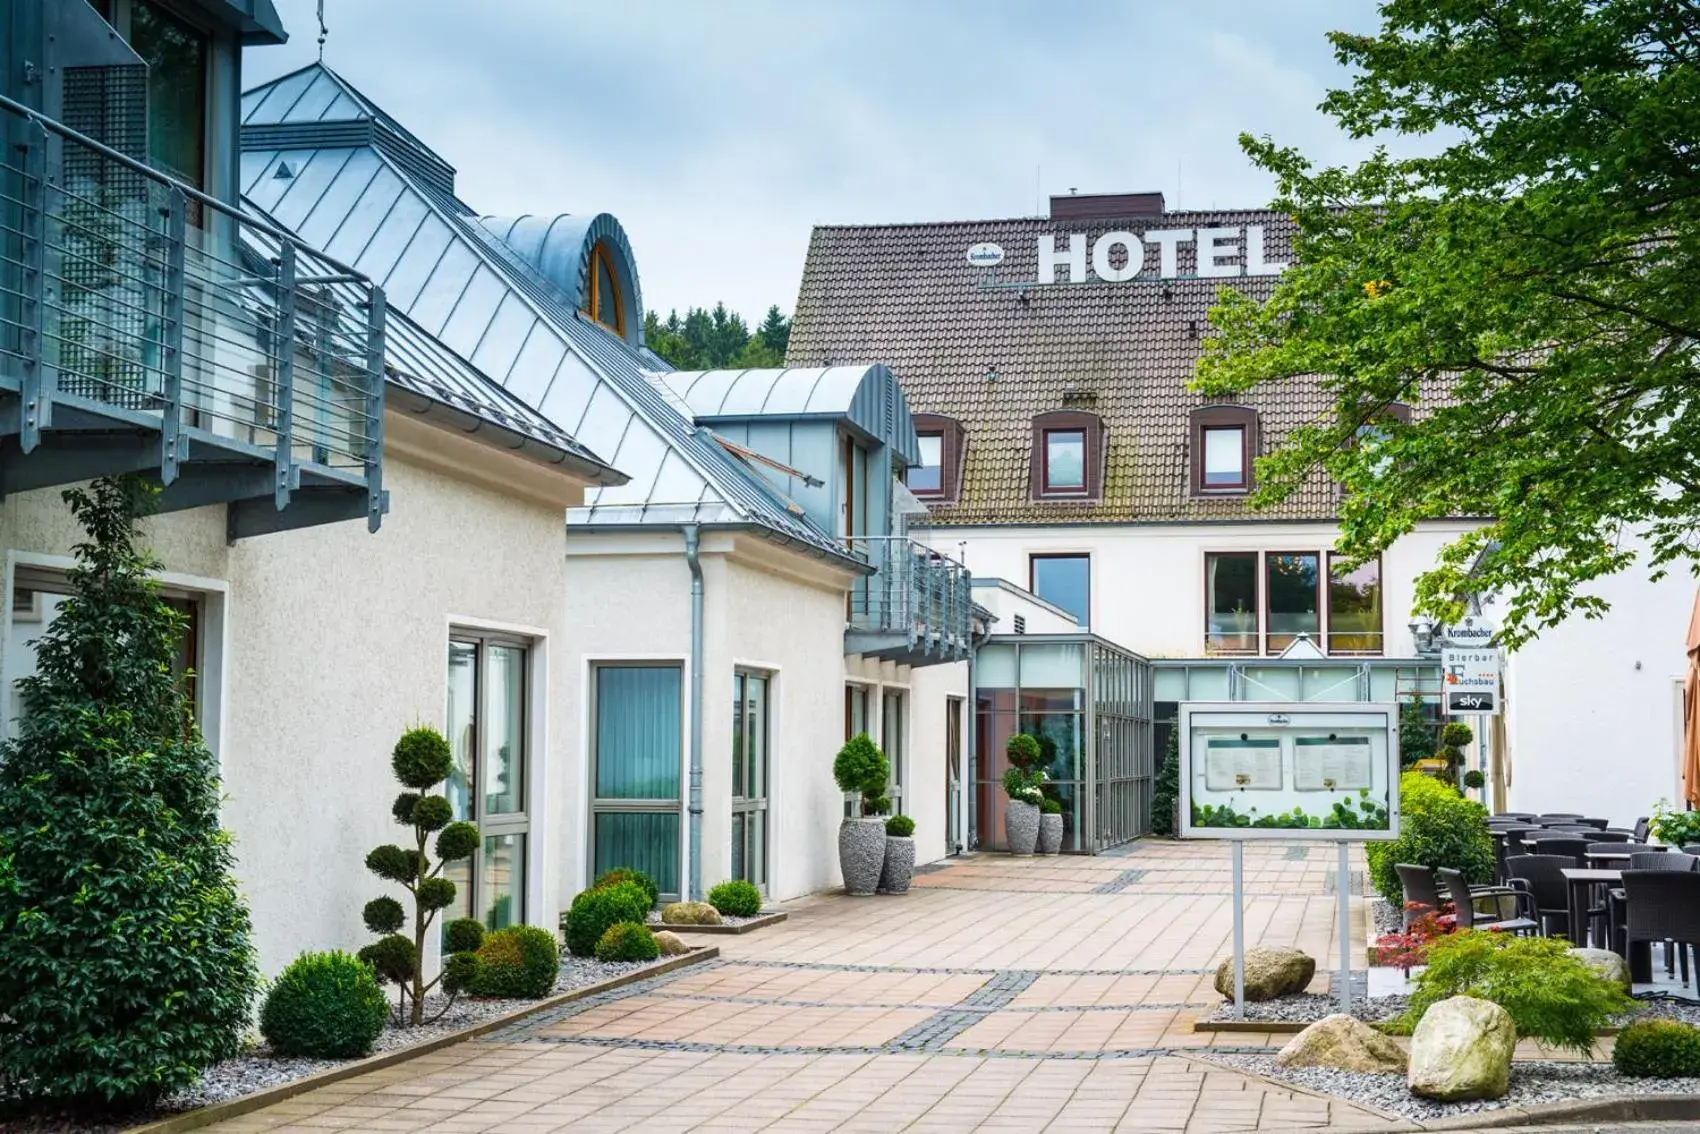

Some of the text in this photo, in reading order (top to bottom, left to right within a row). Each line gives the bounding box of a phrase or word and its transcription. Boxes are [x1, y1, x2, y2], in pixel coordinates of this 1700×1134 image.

[1037, 226, 1289, 285] HOTEL
[1447, 627, 1492, 638] Krombacher
[1449, 654, 1493, 662] Bierbar
[1459, 695, 1482, 708] sky
